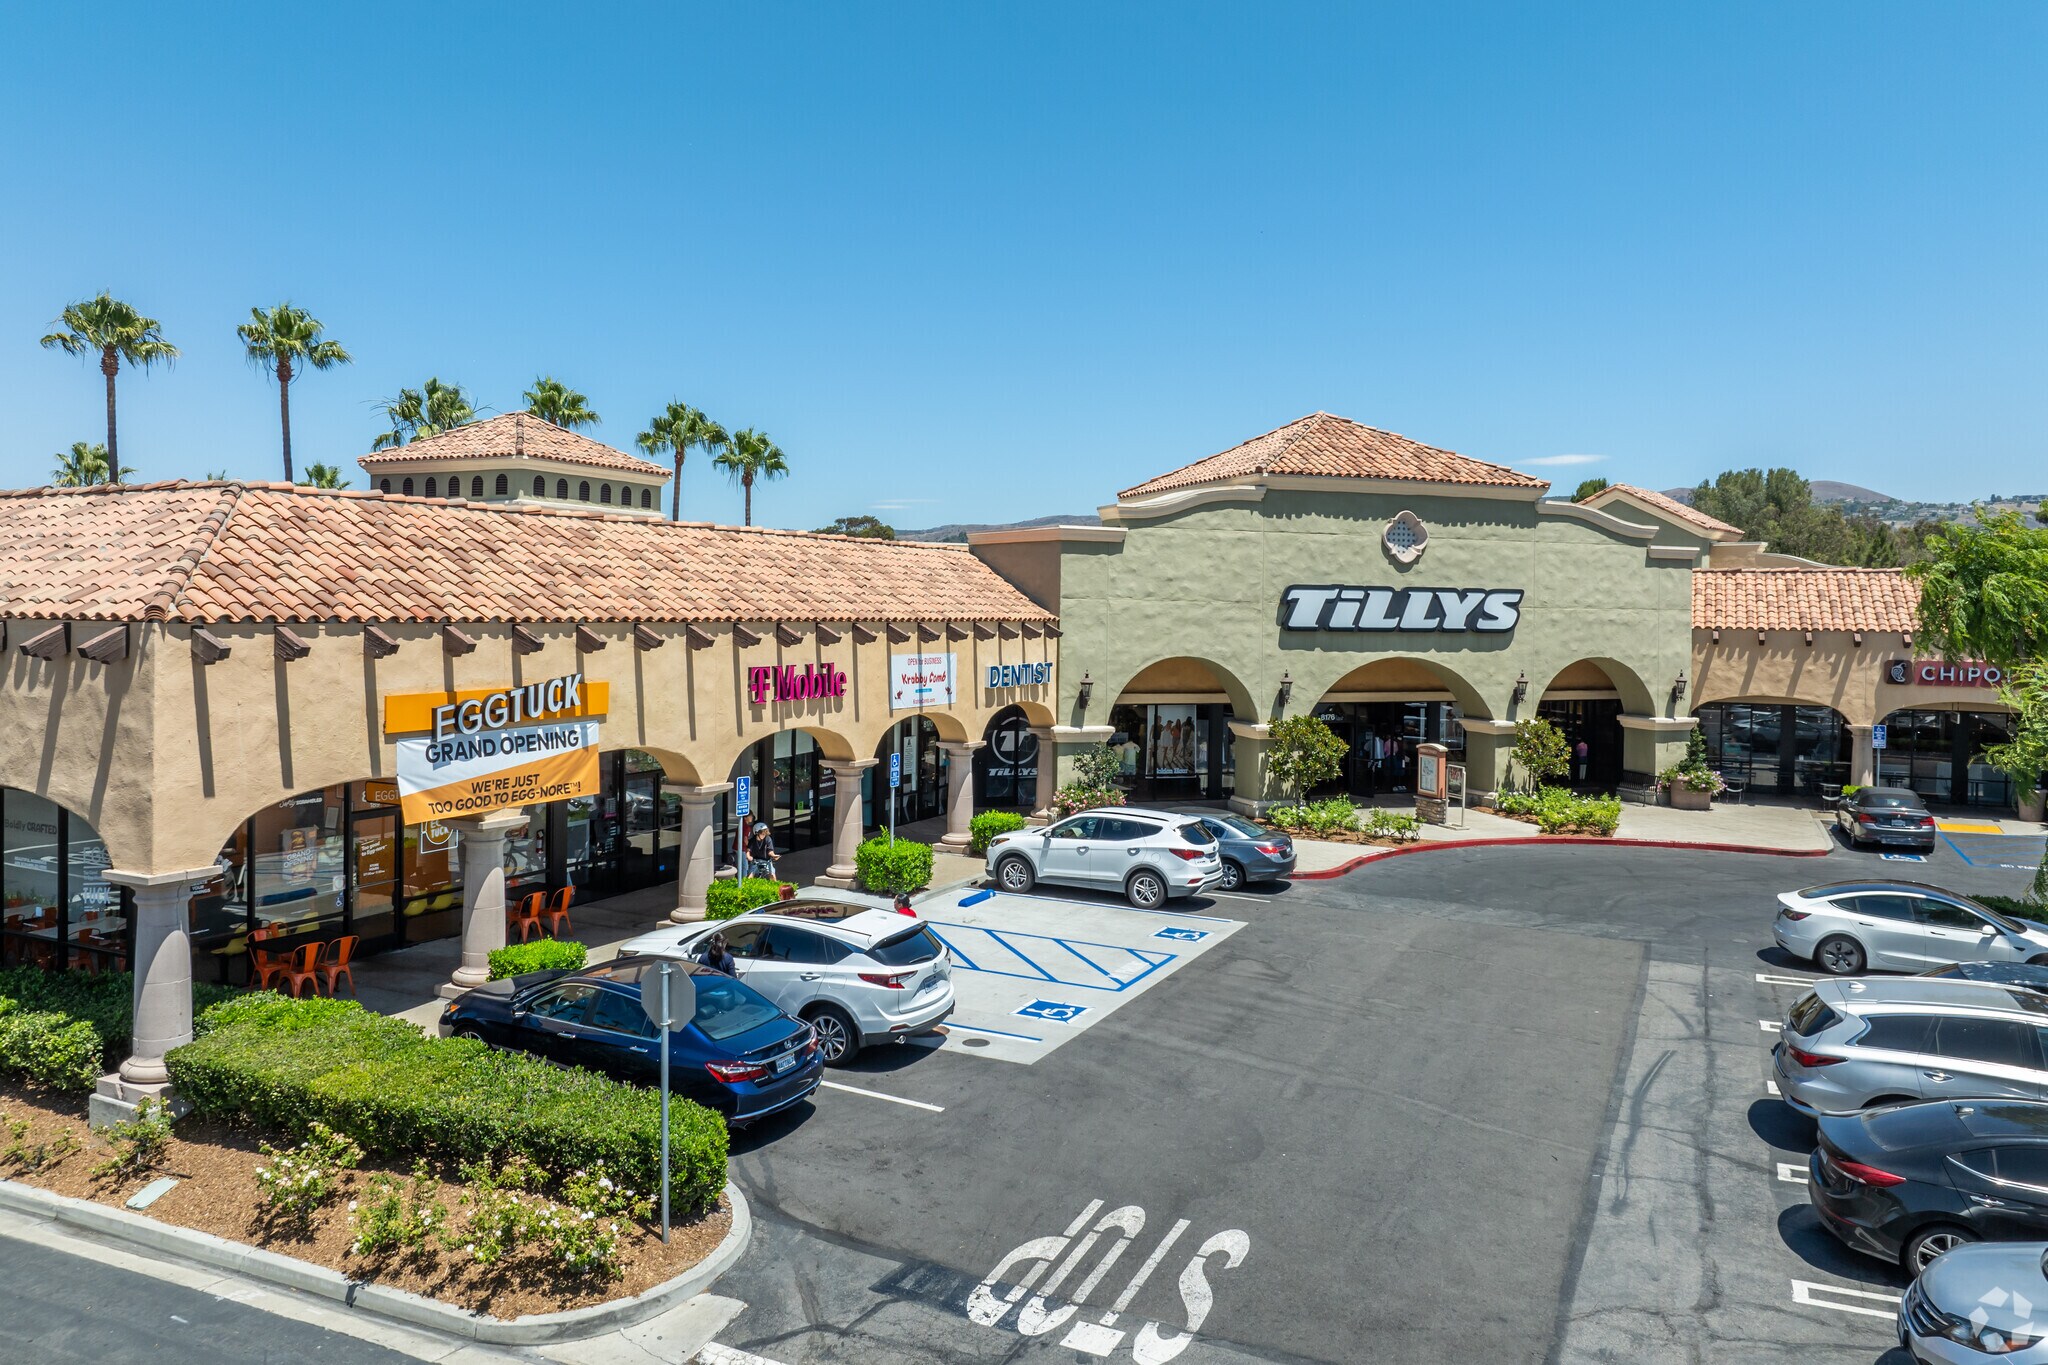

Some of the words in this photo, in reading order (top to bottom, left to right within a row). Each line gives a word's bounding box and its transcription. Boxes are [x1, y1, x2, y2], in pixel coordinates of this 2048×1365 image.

[907, 658, 918, 666] OPEN
[924, 657, 942, 665] BUSINESS
[901, 672, 928, 687] Krabby
[929, 671, 947, 684] Comb
[988, 662, 1053, 688] DENTIST
[1921, 665, 2011, 683] CHIPO
[433, 673, 583, 742] EGGTUCK
[425, 737, 497, 763] GRAND
[500, 730, 580, 753] OPENING
[471, 776, 510, 794] WE'RE
[511, 773, 540, 789] JUST
[428, 801, 453, 814] TOO
[455, 796, 492, 811] GOOD
[493, 792, 510, 804] TO
[26, 821, 58, 834] CRAFTED
[283, 854, 314, 868] OPENING
[287, 849, 311, 861] GRAND
[967, 1199, 1251, 1365] STOP
